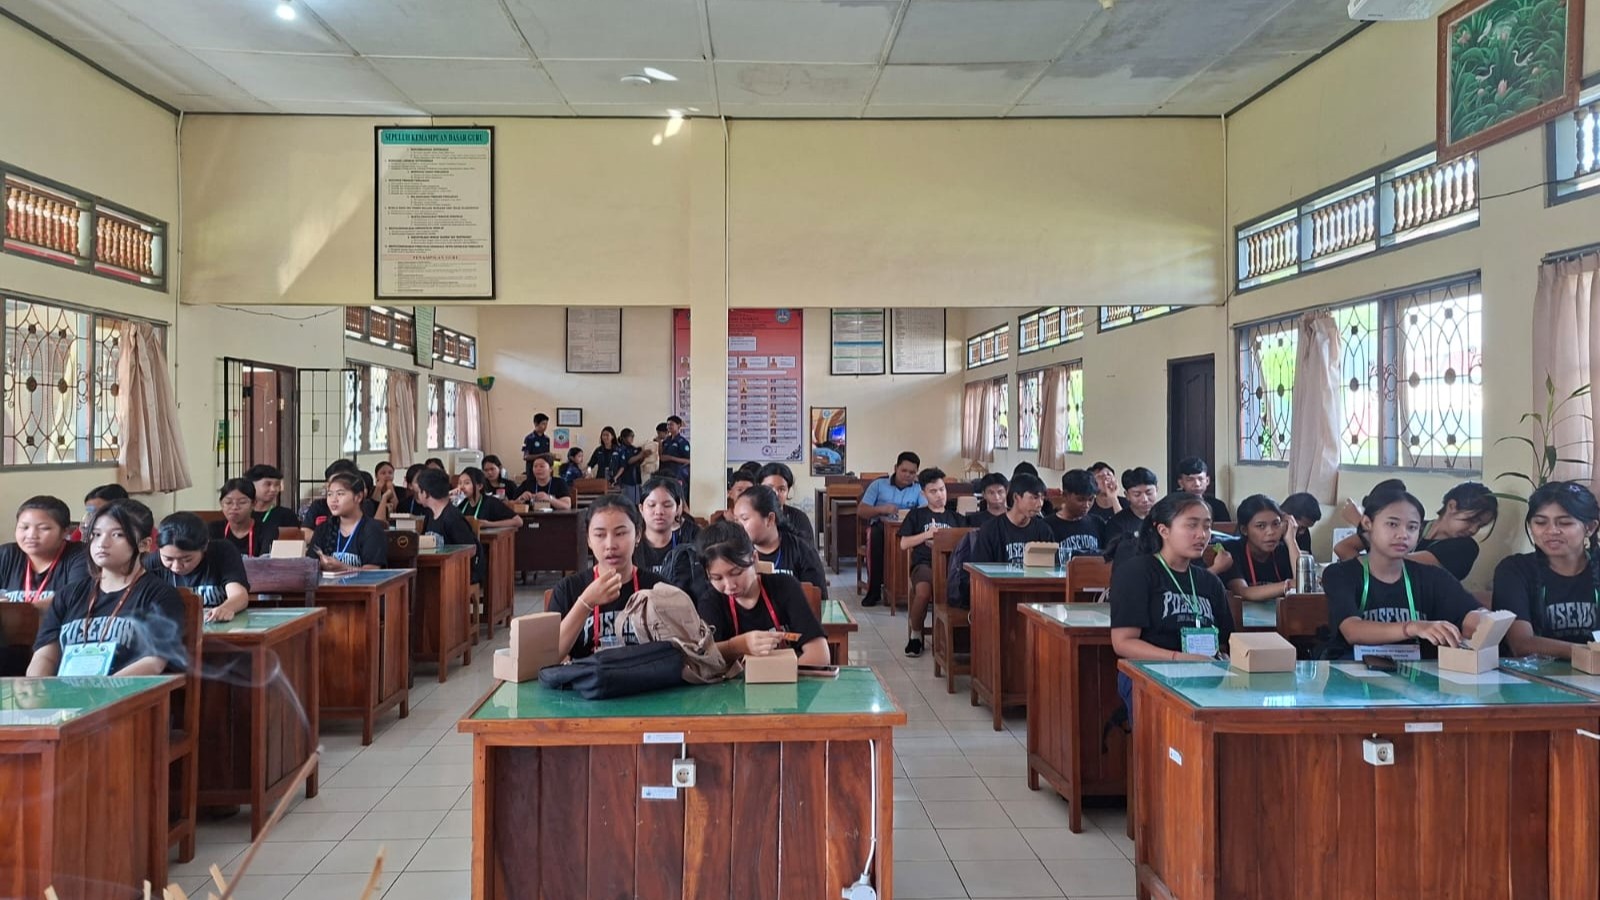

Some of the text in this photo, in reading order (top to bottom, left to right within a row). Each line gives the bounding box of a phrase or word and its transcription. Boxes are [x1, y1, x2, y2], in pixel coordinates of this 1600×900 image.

[385, 132, 483, 142] SEPULUH KEMAMPUAN DASAR GURU
